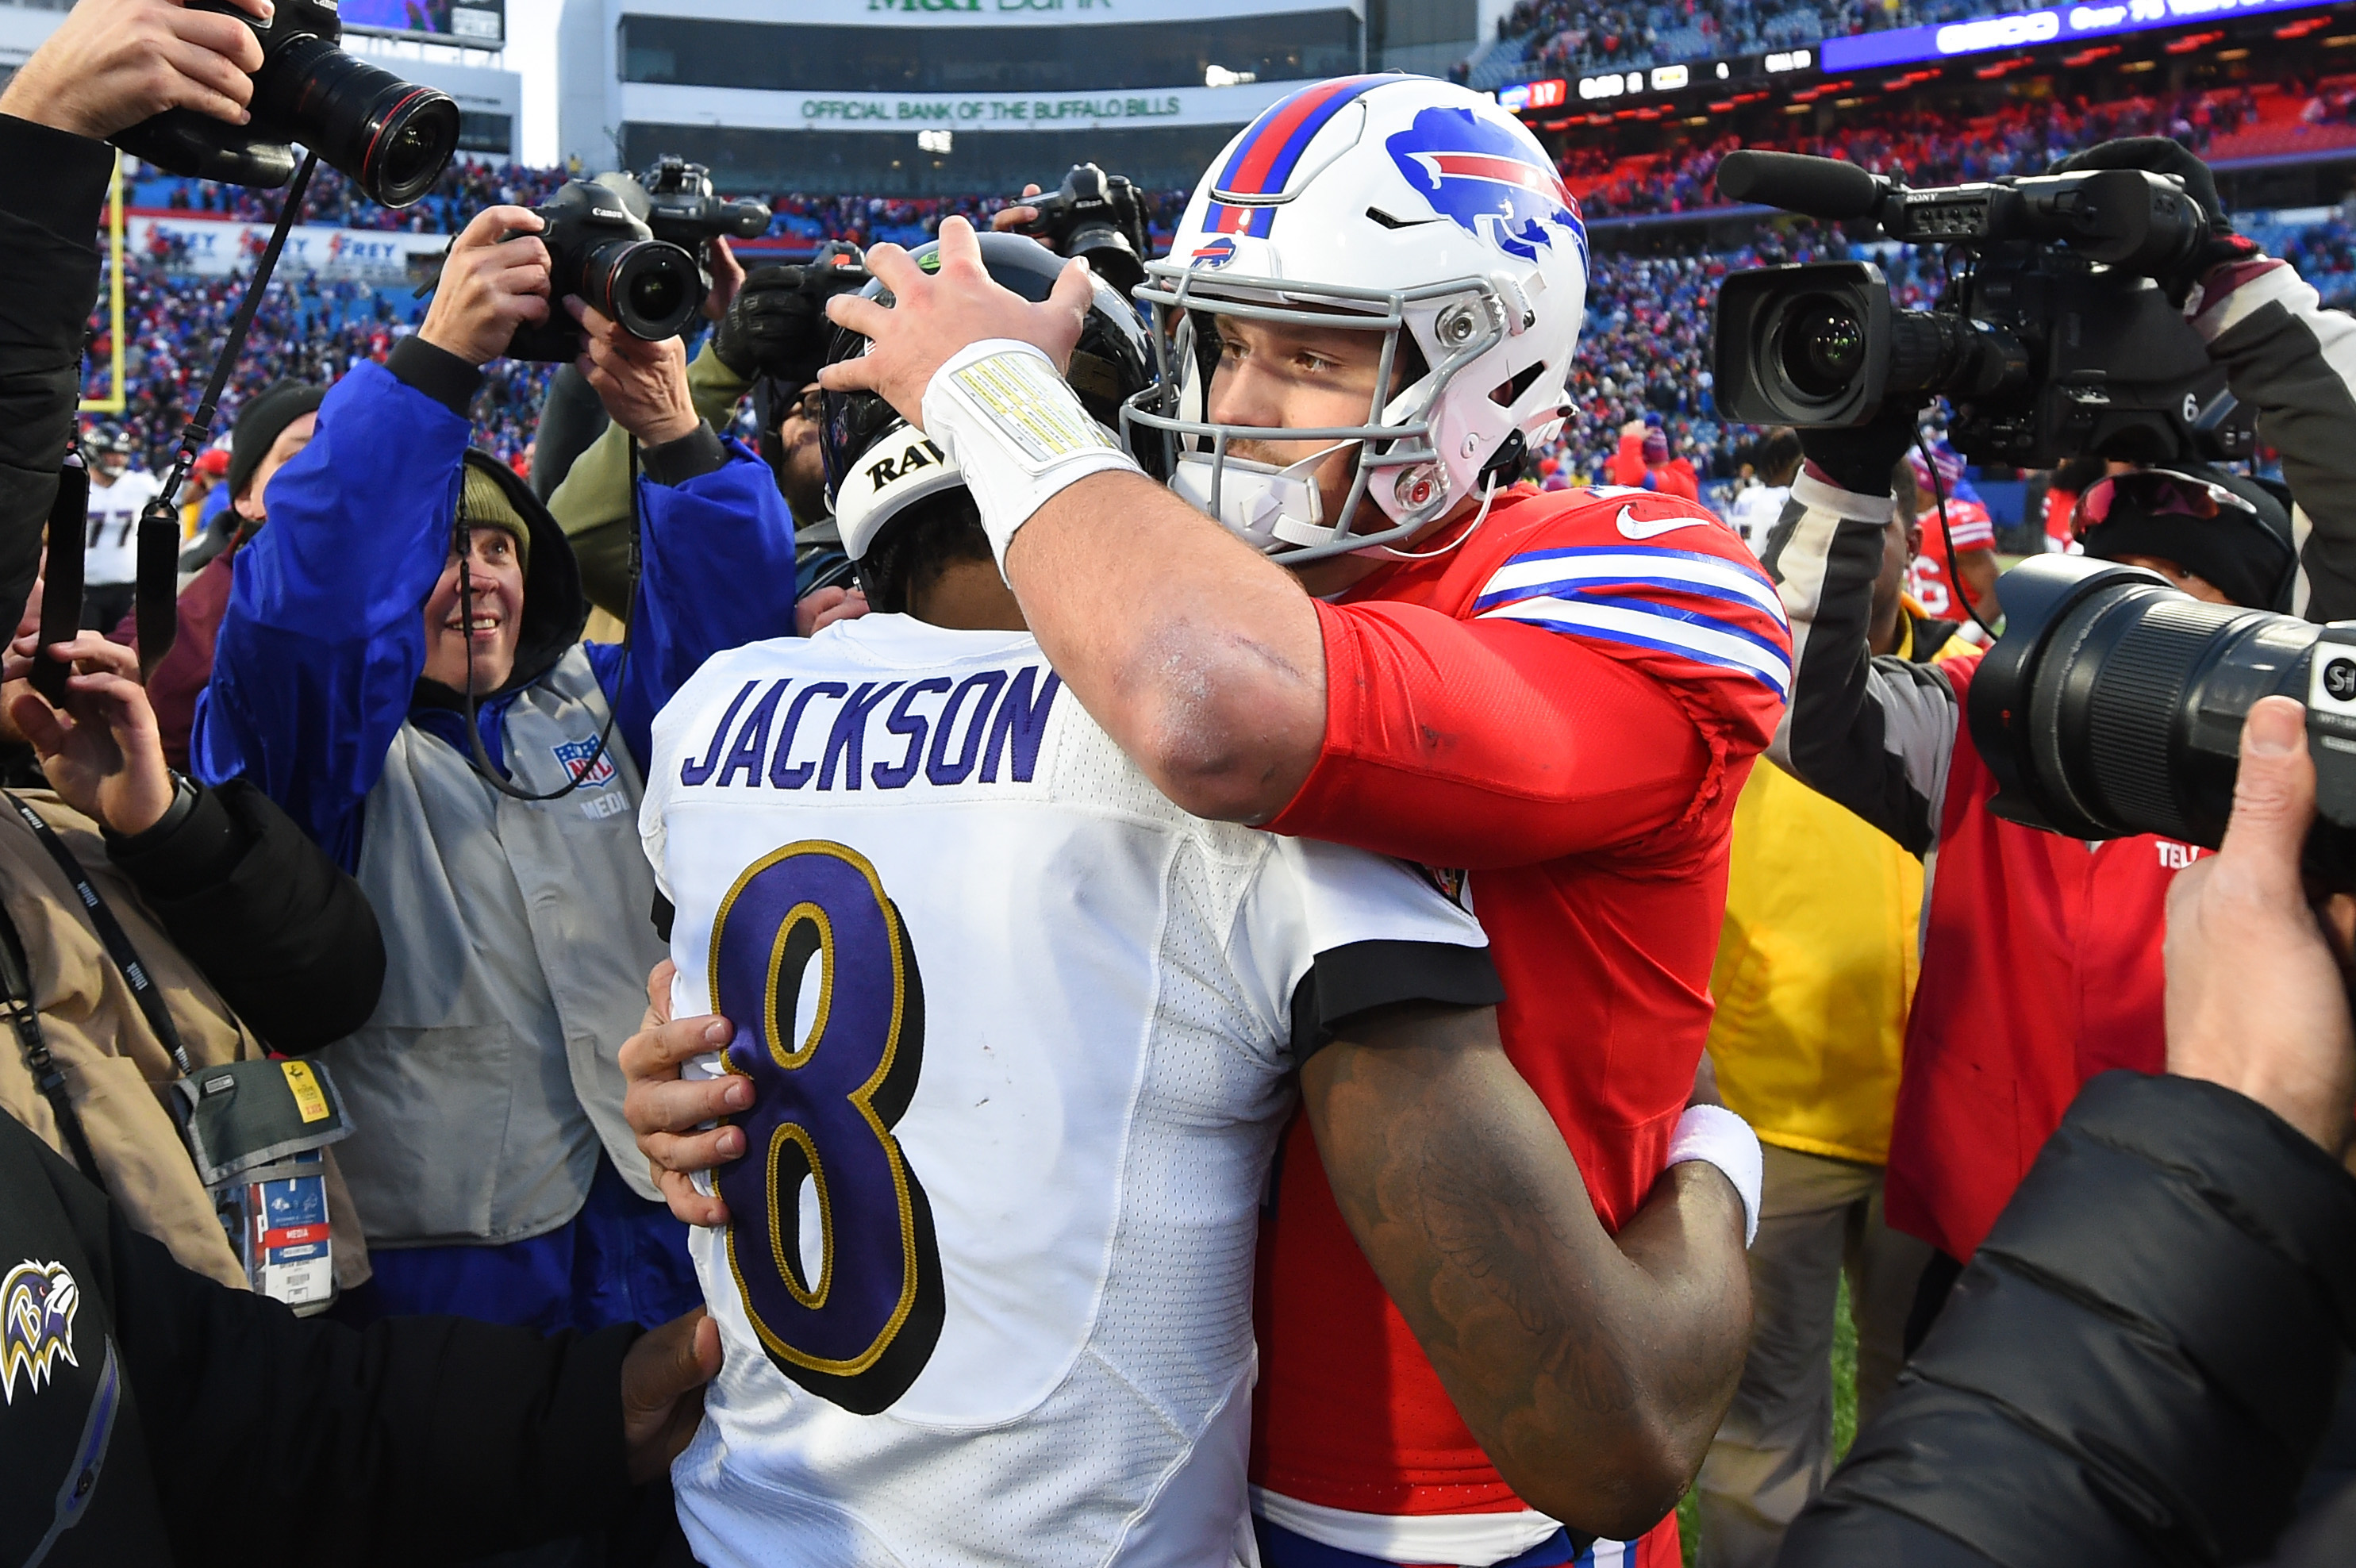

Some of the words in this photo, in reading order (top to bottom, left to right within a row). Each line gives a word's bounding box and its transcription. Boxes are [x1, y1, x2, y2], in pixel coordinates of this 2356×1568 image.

[801, 101, 892, 120] OFFICIAL
[897, 101, 952, 120] BANK
[959, 101, 984, 120] OF
[990, 101, 1028, 120] THE
[1034, 98, 1123, 119] BUFFALO
[1126, 96, 1180, 117] BILLS
[1906, 192, 1937, 202] SONY
[592, 207, 623, 218] Canon
[2183, 393, 2200, 423] 6
[86, 509, 133, 548] 77
[680, 665, 1062, 792] JACKSON
[21, 808, 44, 829] think
[77, 881, 98, 907] think
[126, 961, 148, 990] think
[708, 839, 947, 1416] 8
